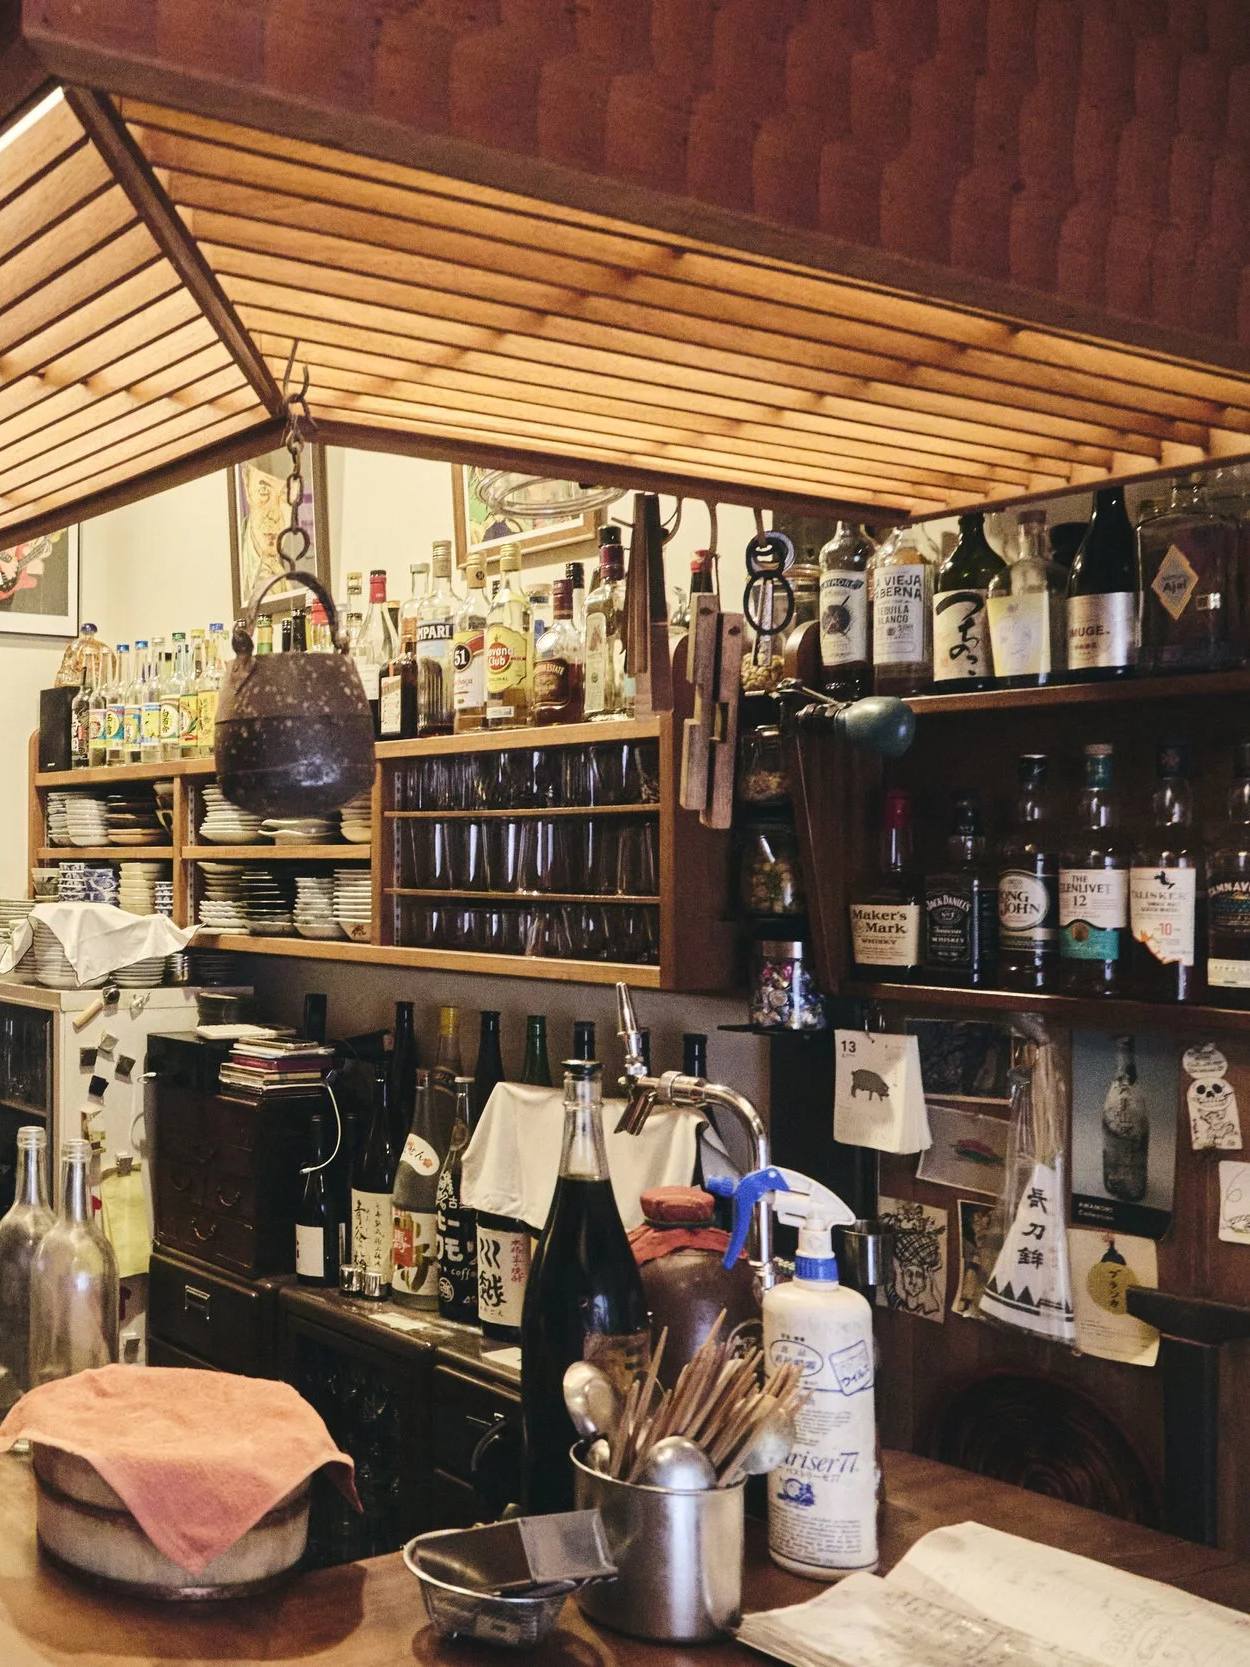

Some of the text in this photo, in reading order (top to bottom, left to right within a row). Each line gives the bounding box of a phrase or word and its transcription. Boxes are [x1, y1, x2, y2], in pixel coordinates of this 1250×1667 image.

[884, 574, 922, 587] VIEJA
[454, 649, 467, 666] 51
[487, 647, 514, 657] avana
[488, 656, 506, 666] Club
[1071, 875, 1088, 883] THE
[1072, 895, 1088, 907] 12
[852, 909, 907, 921] Maker's
[1000, 903, 1041, 916] JOHN
[865, 922, 907, 934] Mark
[1158, 923, 1173, 936] 10
[840, 1040, 856, 1053] 13
[1017, 1187, 1048, 1270] 長刀鉾
